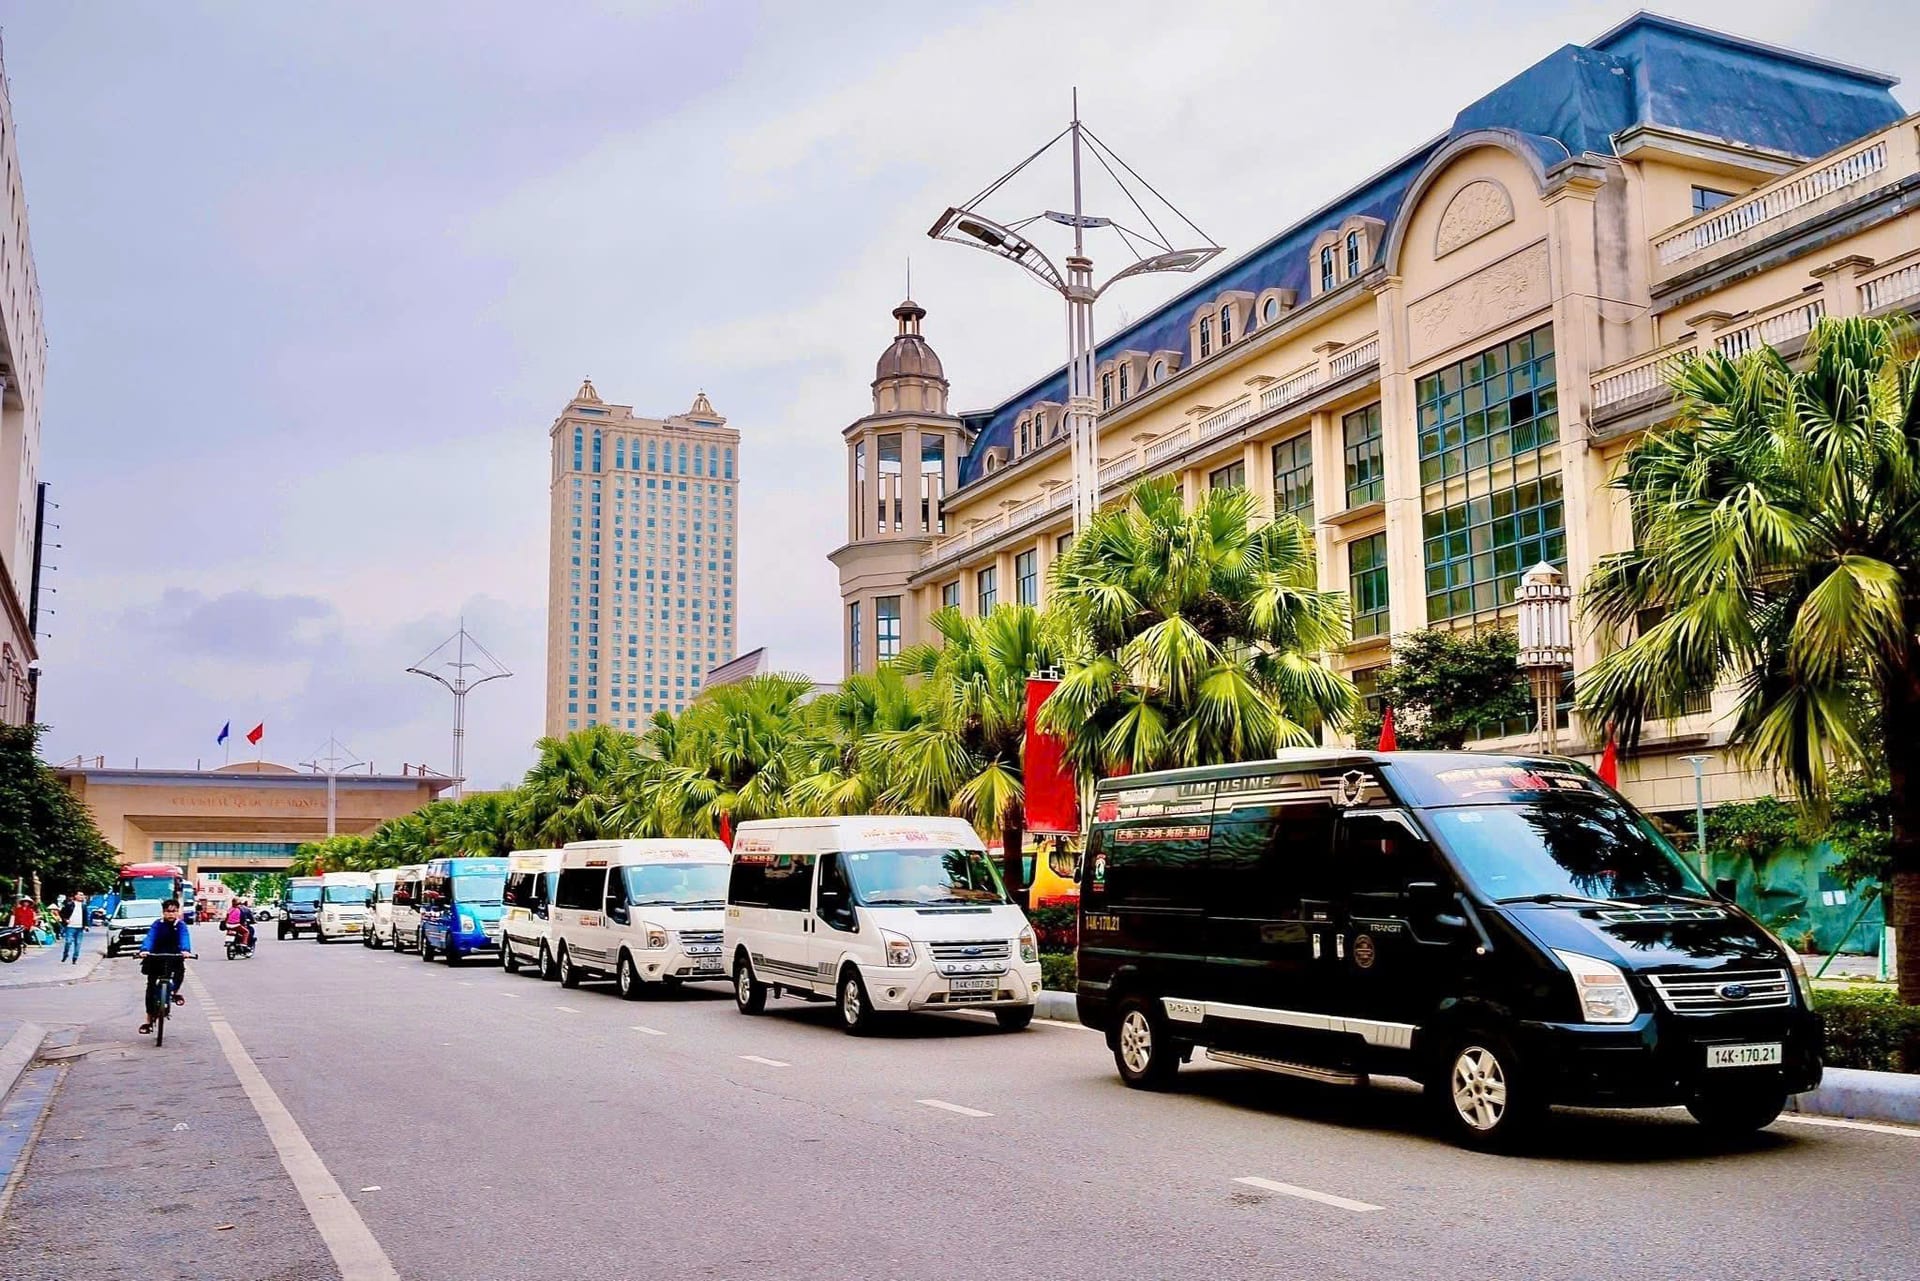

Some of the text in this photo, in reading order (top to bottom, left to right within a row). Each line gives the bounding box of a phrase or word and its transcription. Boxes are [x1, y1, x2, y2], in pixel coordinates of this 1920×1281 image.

[1180, 776, 1271, 796] LIMOUSINE
[1085, 915, 1120, 931] 14K-170.21
[1369, 924, 1402, 933] TRANSIT
[947, 962, 1002, 972] DCAR
[1167, 1002, 1201, 1015] DCAR
[1715, 1047, 1776, 1065] 14K-170.21
